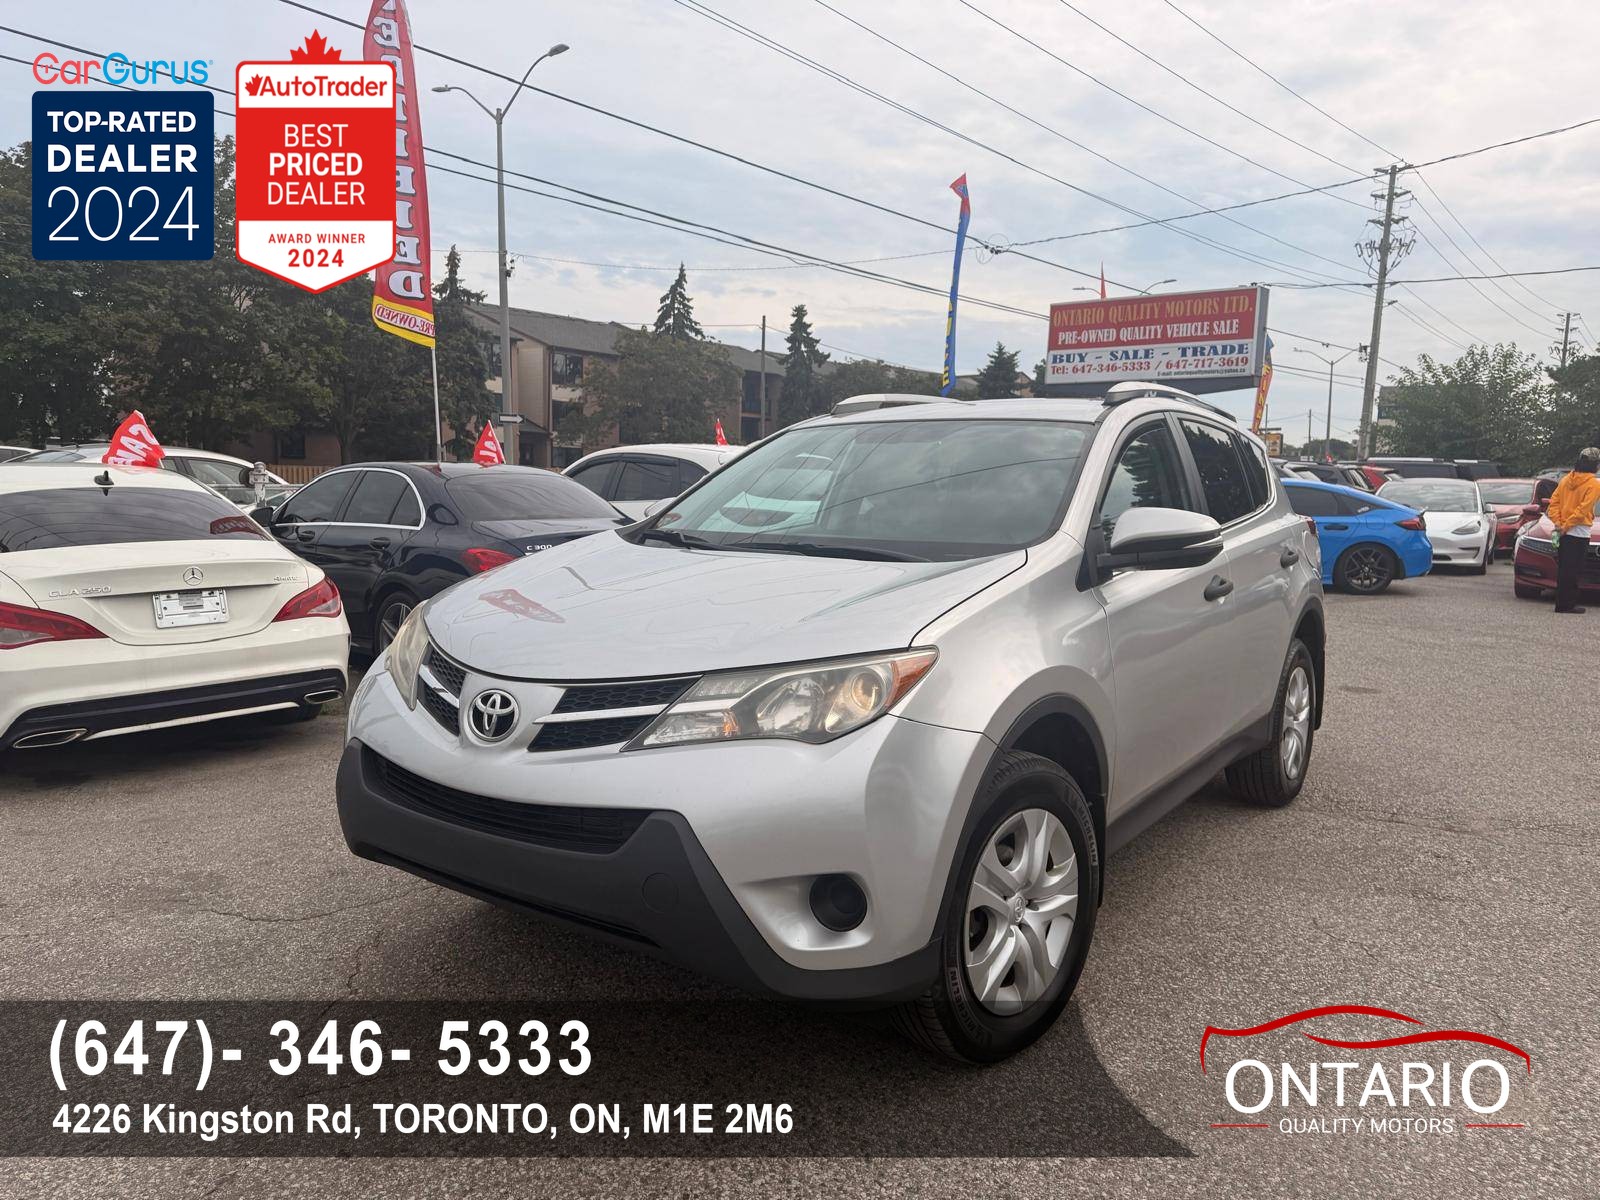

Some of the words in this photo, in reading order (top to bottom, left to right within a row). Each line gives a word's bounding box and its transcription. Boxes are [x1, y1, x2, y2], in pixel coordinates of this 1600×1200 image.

[1053, 306, 1105, 327] ONTARIO
[1108, 303, 1160, 324] QUALITY
[1165, 297, 1220, 318] MOTORS
[1223, 295, 1253, 314] LTD.
[1057, 328, 1117, 345] PRE-OWNED
[1119, 325, 1164, 341] QUALITY
[1166, 321, 1211, 338] VEHICLE
[1212, 318, 1239, 335] SALE
[1051, 352, 1088, 364] BUY
[1109, 348, 1154, 361] SALE
[1177, 343, 1249, 358] TRADE
[1051, 365, 1069, 375] Tel:
[1071, 360, 1151, 374] 647-346-5333
[1165, 355, 1249, 370] 647-717-3619
[48, 590, 80, 600] CLA
[81, 585, 112, 595] 250
